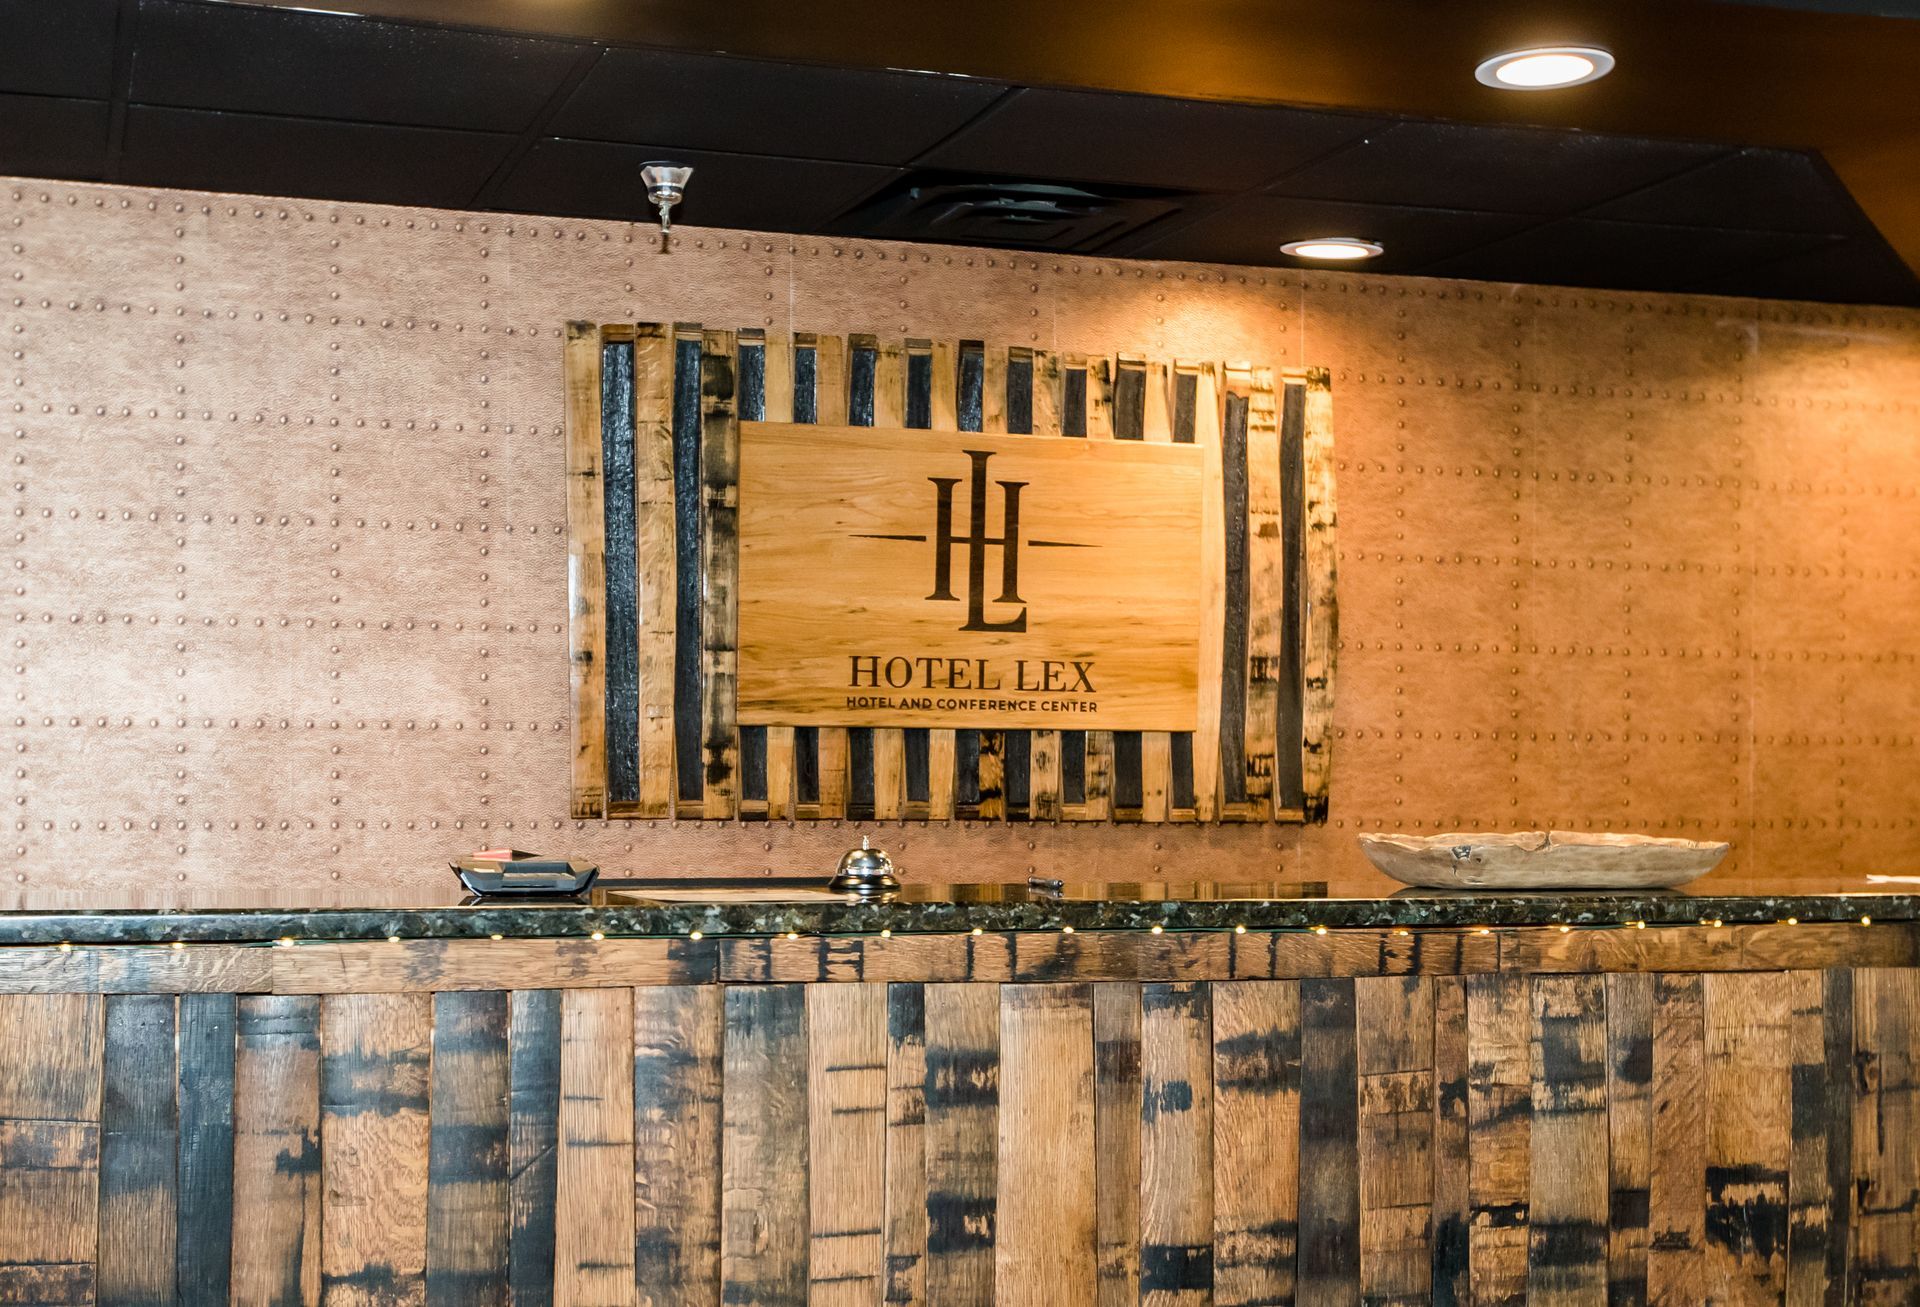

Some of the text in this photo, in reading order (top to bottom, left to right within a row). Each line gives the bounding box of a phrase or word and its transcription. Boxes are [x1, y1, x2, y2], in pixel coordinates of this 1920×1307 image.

[848, 655, 1097, 693] HOTEL LEX
[846, 696, 1098, 713] HOTEL AND CONFERENCE CENTER
